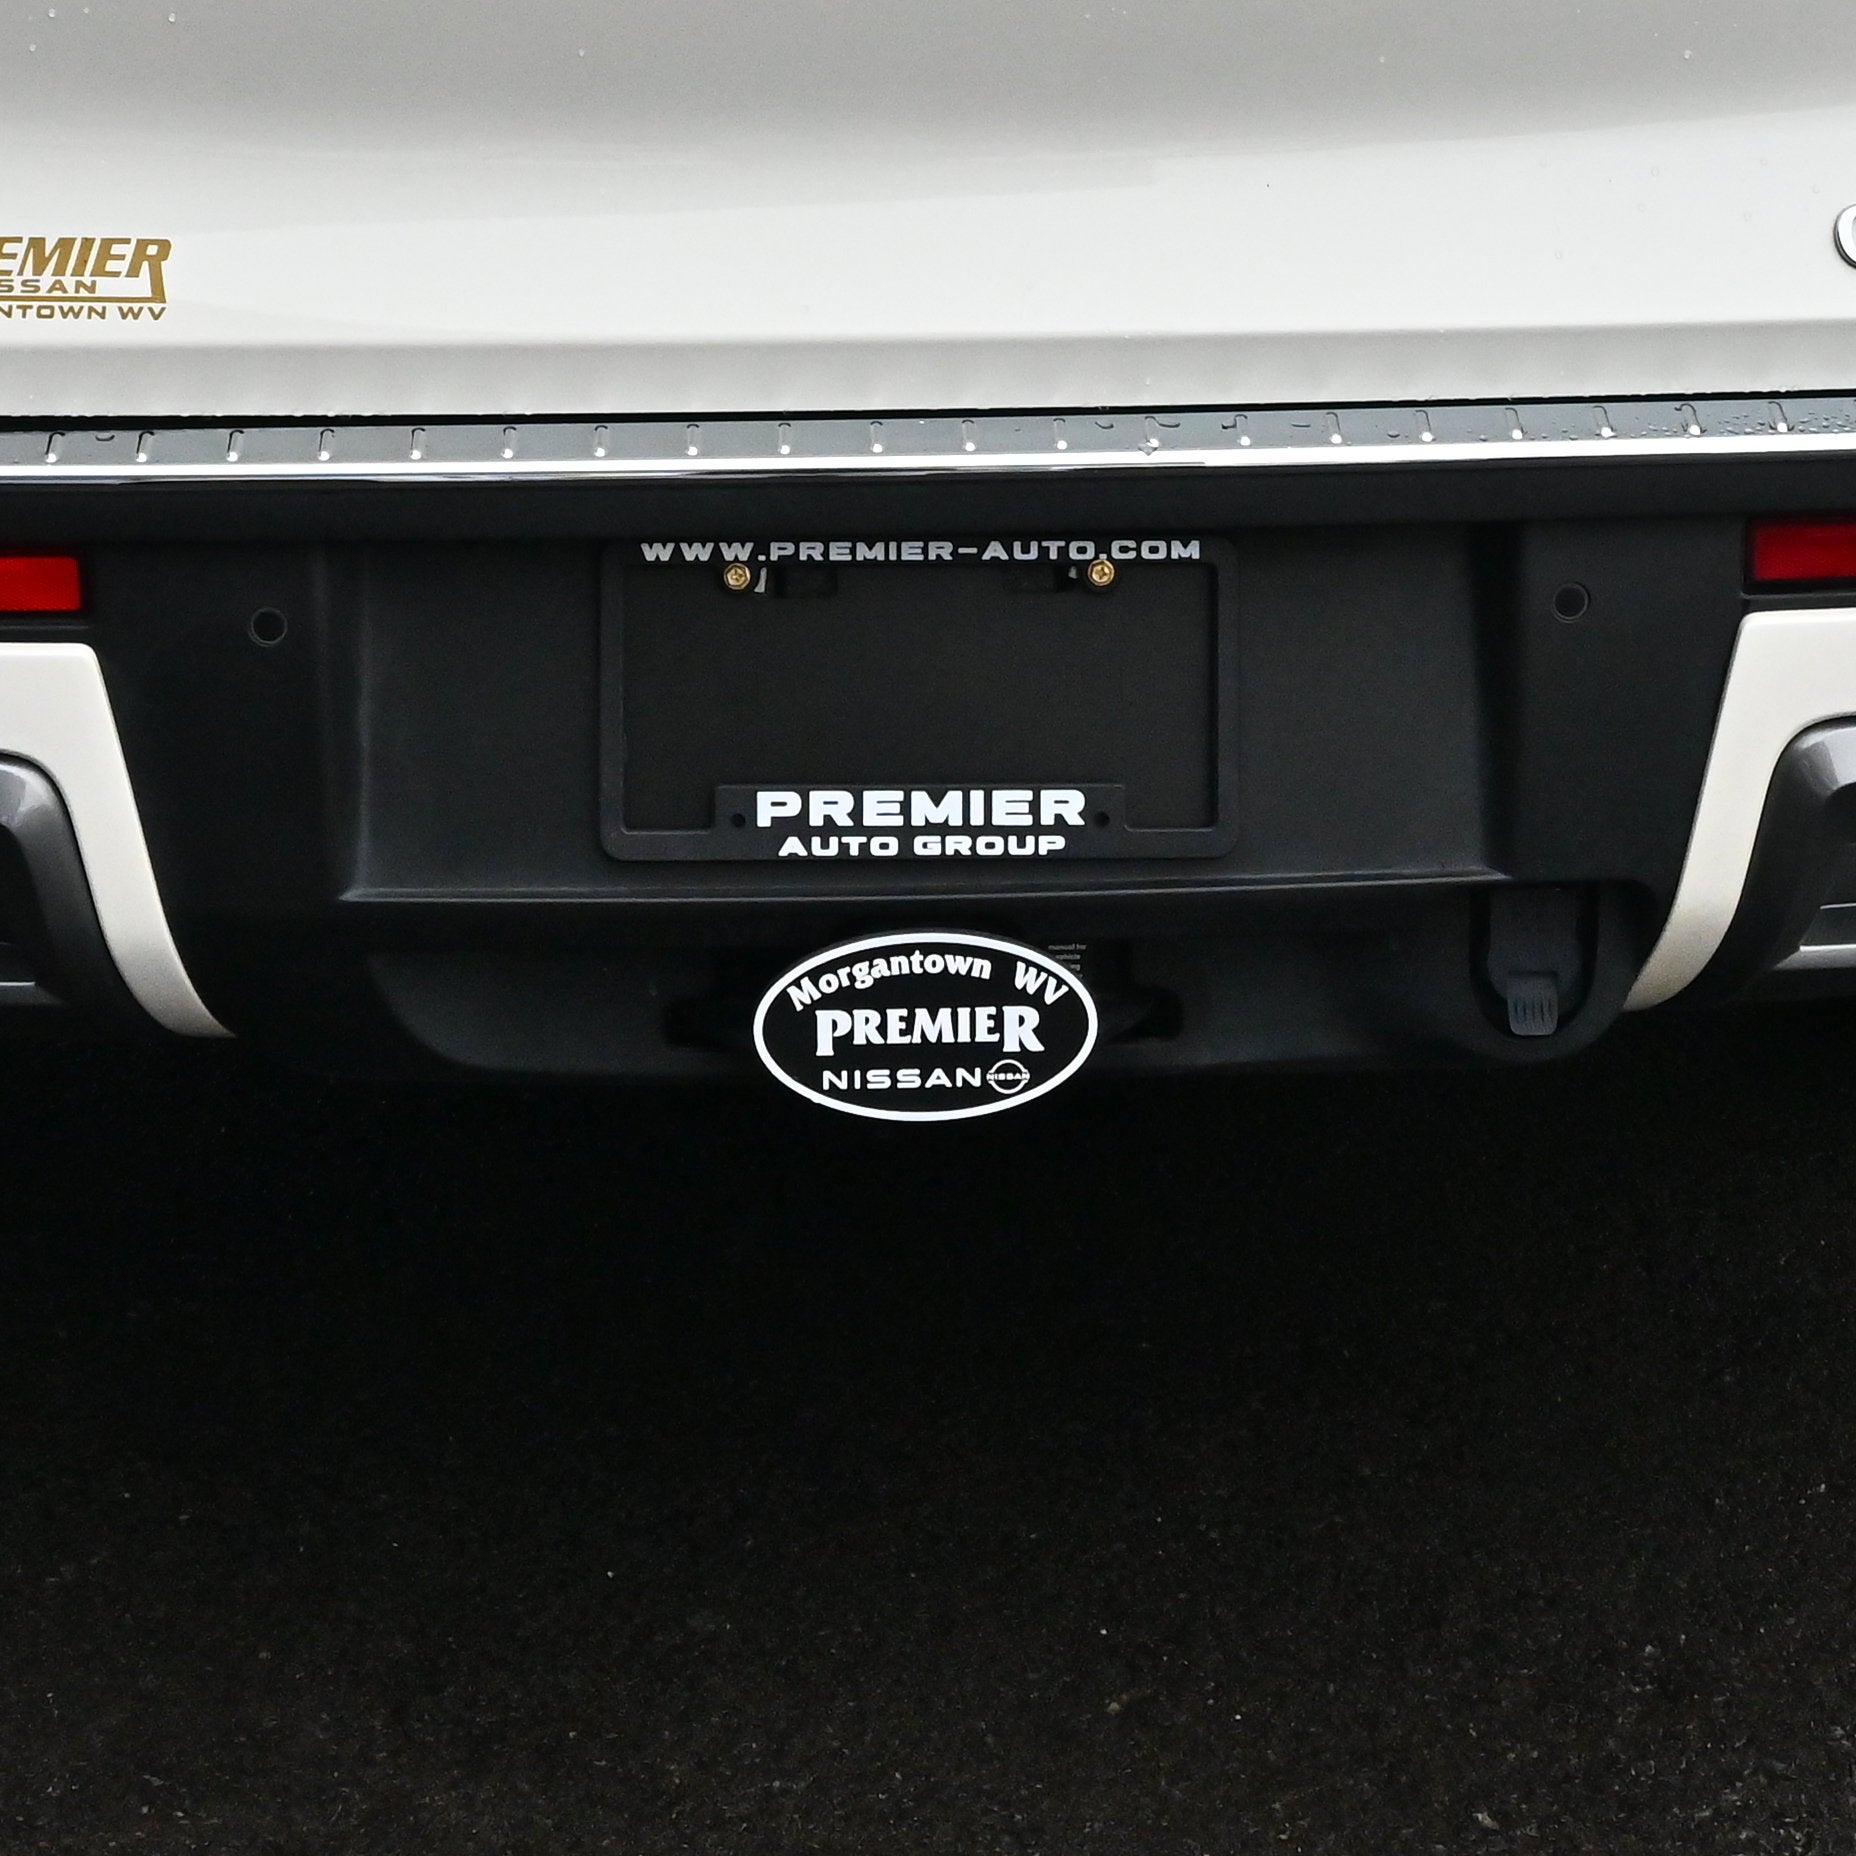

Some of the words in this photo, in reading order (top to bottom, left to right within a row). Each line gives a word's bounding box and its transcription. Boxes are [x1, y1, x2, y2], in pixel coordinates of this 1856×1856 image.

[117, 306, 167, 322] WV
[640, 539, 1201, 562] WWW.PREMIER-AUTO.COM
[755, 788, 1086, 828] PREMIER
[777, 835, 899, 857] AUTO
[912, 834, 1067, 857] GROUP
[785, 949, 992, 1012] Morgantown
[1014, 961, 1070, 1006] WV
[815, 1005, 1045, 1057] PREMIER
[822, 1066, 982, 1091] NISSAN
[986, 1072, 1031, 1081] NISSAN
